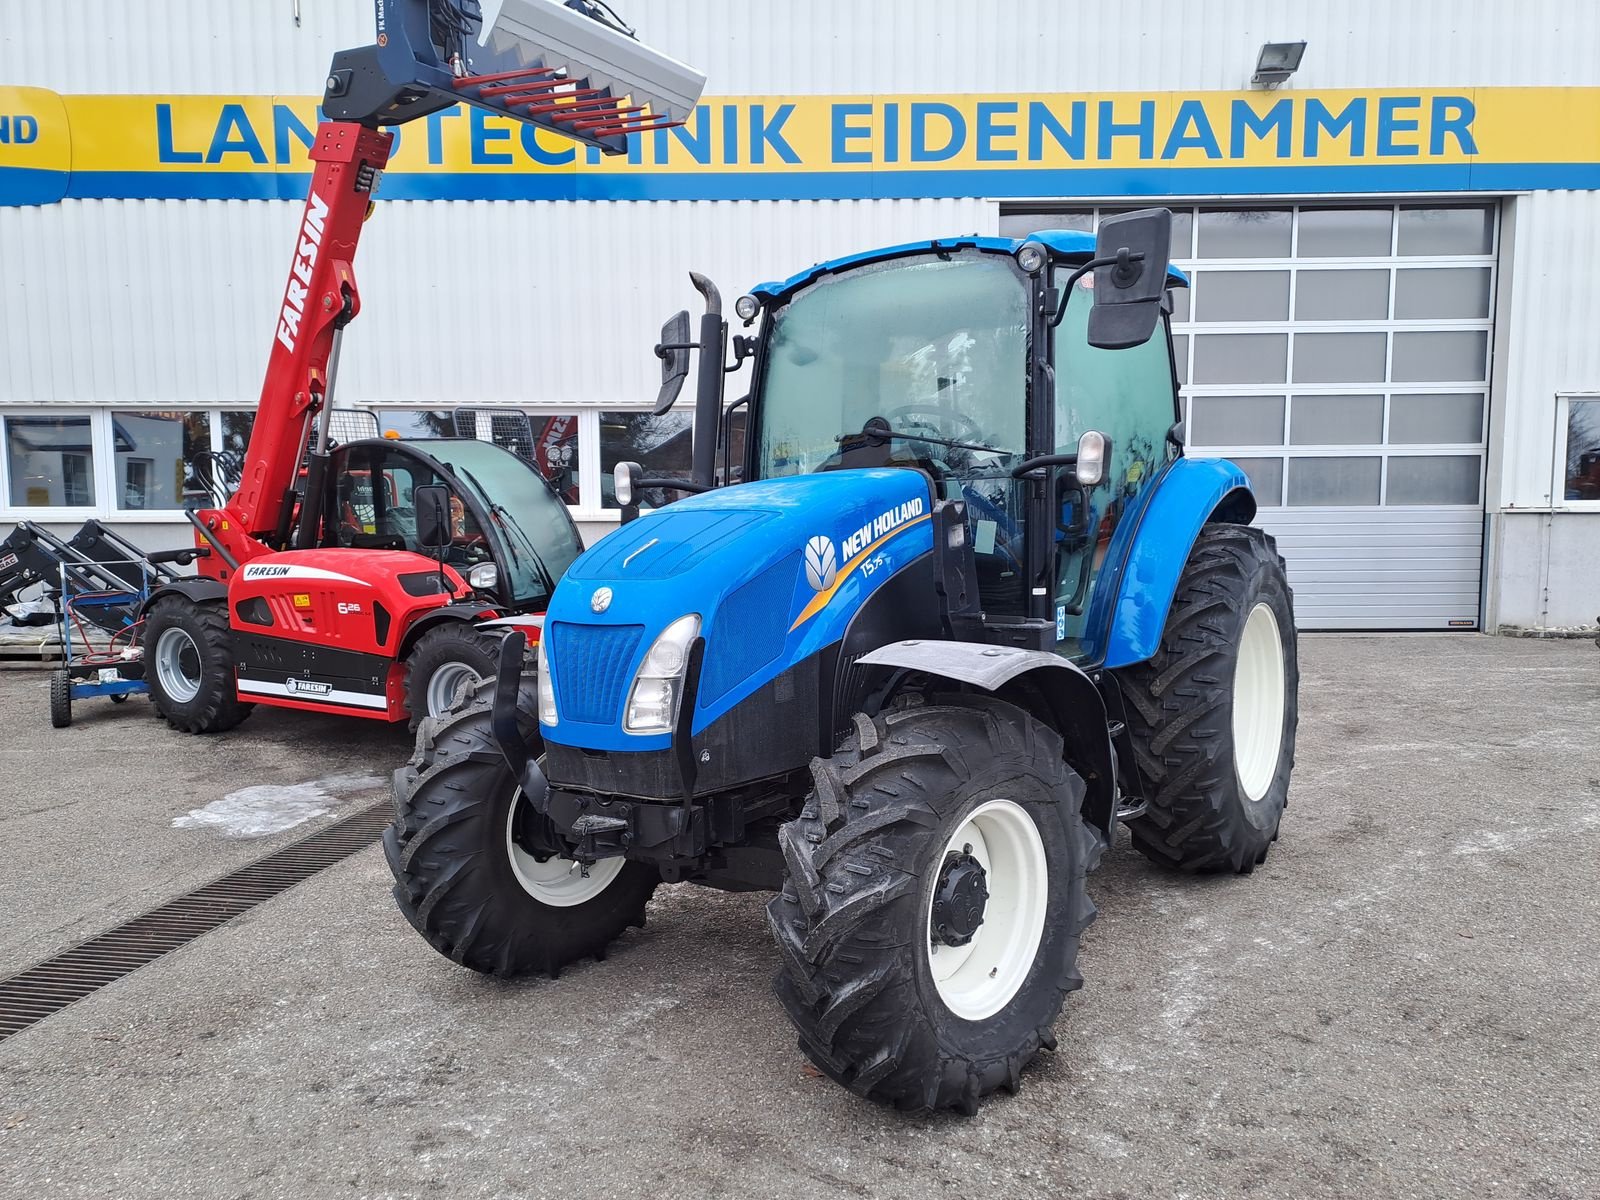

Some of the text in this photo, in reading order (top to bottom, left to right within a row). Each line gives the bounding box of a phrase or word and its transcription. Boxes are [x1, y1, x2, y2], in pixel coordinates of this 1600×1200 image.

[155, 96, 1480, 165] LANTECNIK EIDENHAMMER
[277, 190, 329, 353] FARESIN
[842, 497, 923, 562] NEW HOLLAND
[246, 566, 291, 577] FARESIN
[337, 602, 361, 614] 626
[297, 682, 327, 693] FARESIN
